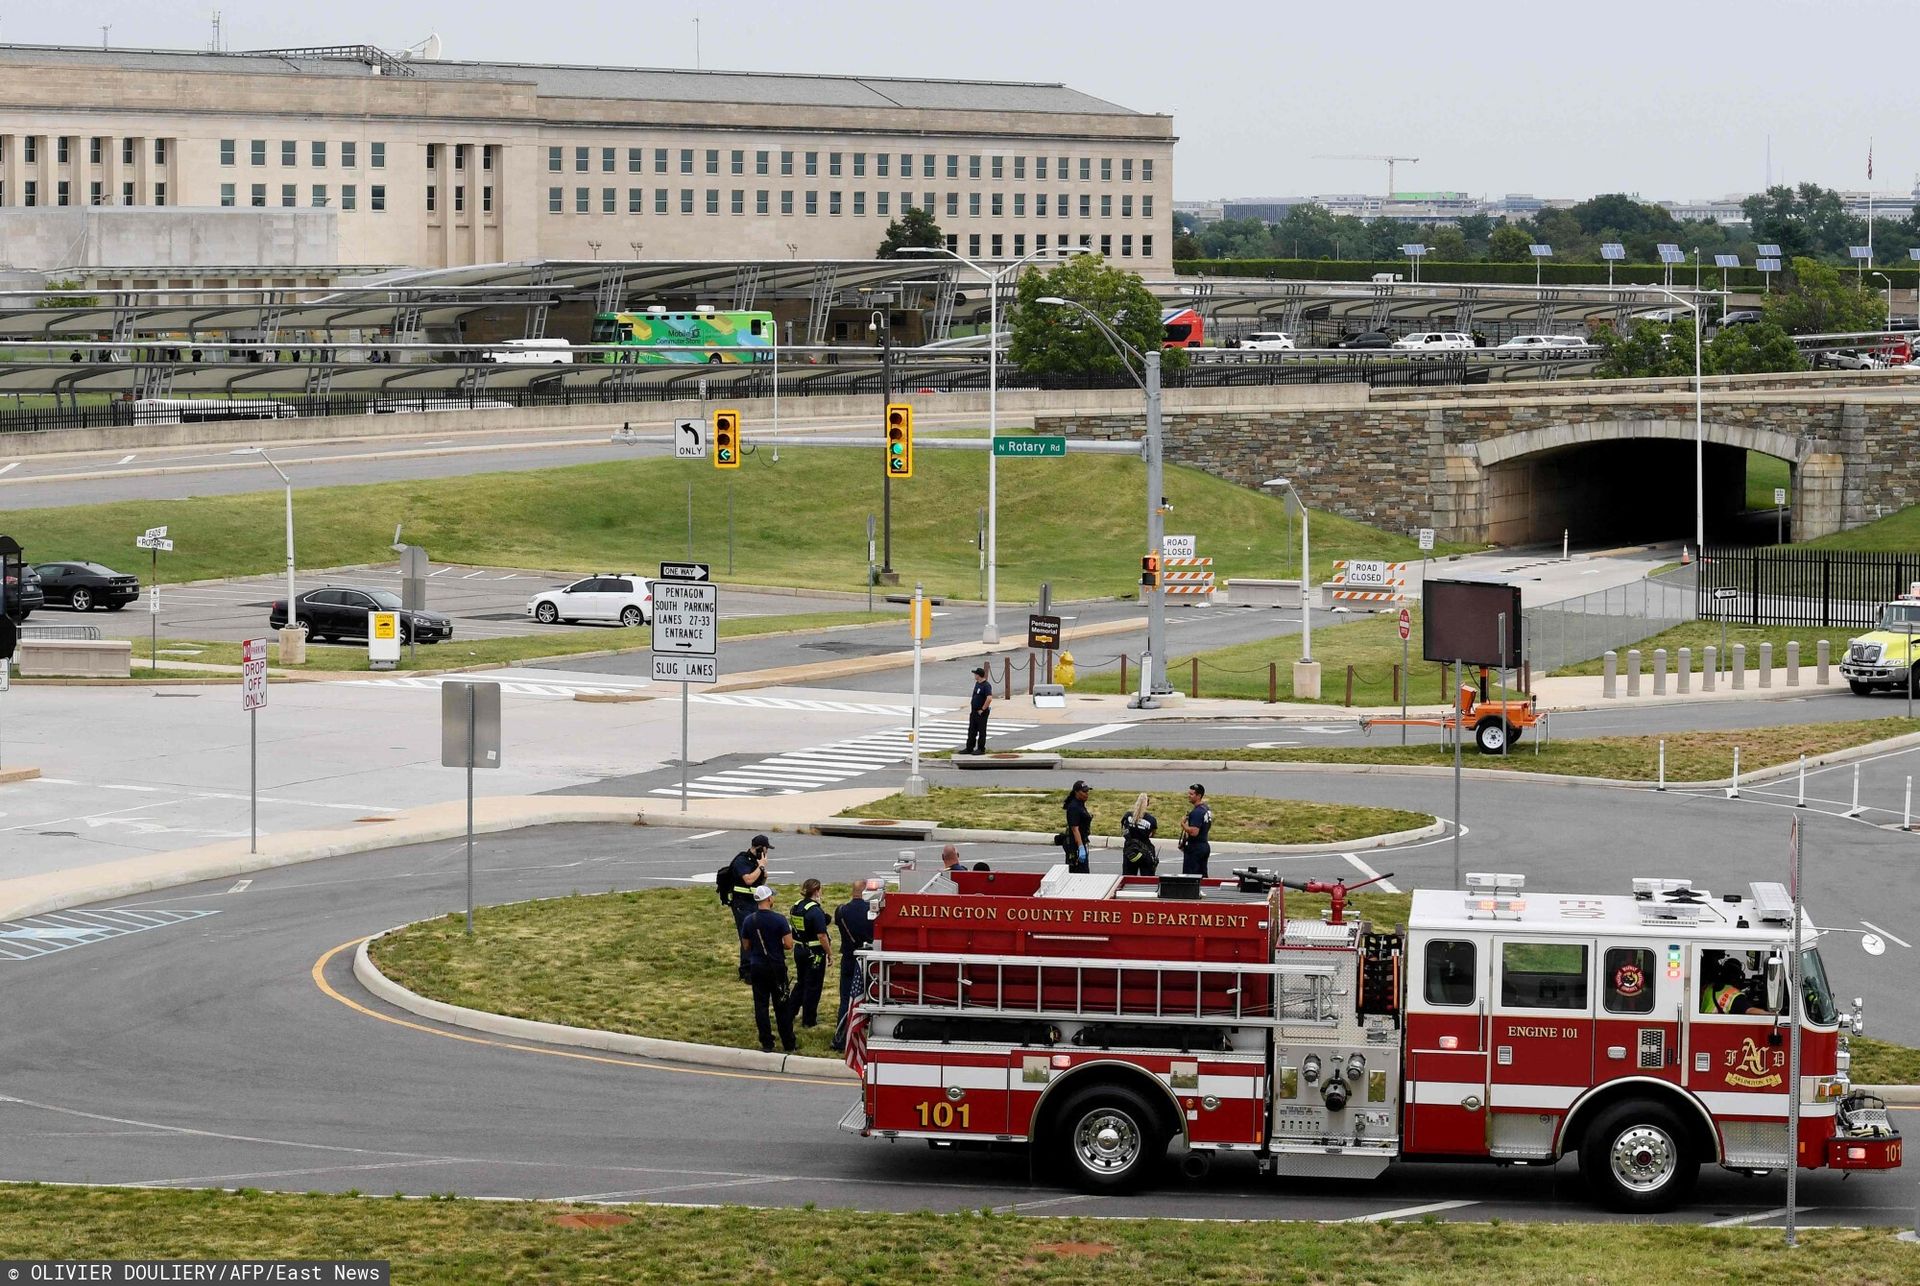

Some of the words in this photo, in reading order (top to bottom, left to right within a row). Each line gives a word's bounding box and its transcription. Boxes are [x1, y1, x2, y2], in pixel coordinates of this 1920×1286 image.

[679, 447, 702, 455] ONLY
[1008, 441, 1045, 454] Rotary
[141, 538, 165, 548] ROTARY
[1163, 548, 1192, 556] CLOSED
[665, 567, 678, 575] ONE
[680, 568, 694, 576] WAY
[1356, 563, 1377, 571] ROAD
[1351, 573, 1381, 581] CLOSED
[665, 587, 704, 598] PENTAGON
[655, 600, 677, 611] SOUTH
[684, 602, 714, 612] PARKING
[659, 614, 682, 624] LANES
[689, 615, 710, 626] 27-33
[1031, 620, 1058, 629] Pentagon
[665, 627, 703, 639] ENTRANCE
[1031, 627, 1058, 635] Memorial
[245, 661, 265, 676] DROP
[656, 662, 678, 674] SLUG
[686, 664, 713, 676] LANES
[248, 677, 262, 691] OFF
[245, 692, 265, 707] ONLY
[899, 905, 998, 919] ARLINGTON
[1006, 908, 1075, 921] COUNTY
[1083, 910, 1122, 923] FIRE
[1132, 912, 1249, 928] DEPARTMENT
[1507, 1026, 1558, 1038] ENGINE
[1562, 1028, 1578, 1039] 101
[916, 1101, 970, 1128] 101
[1885, 1143, 1901, 1162] 101
